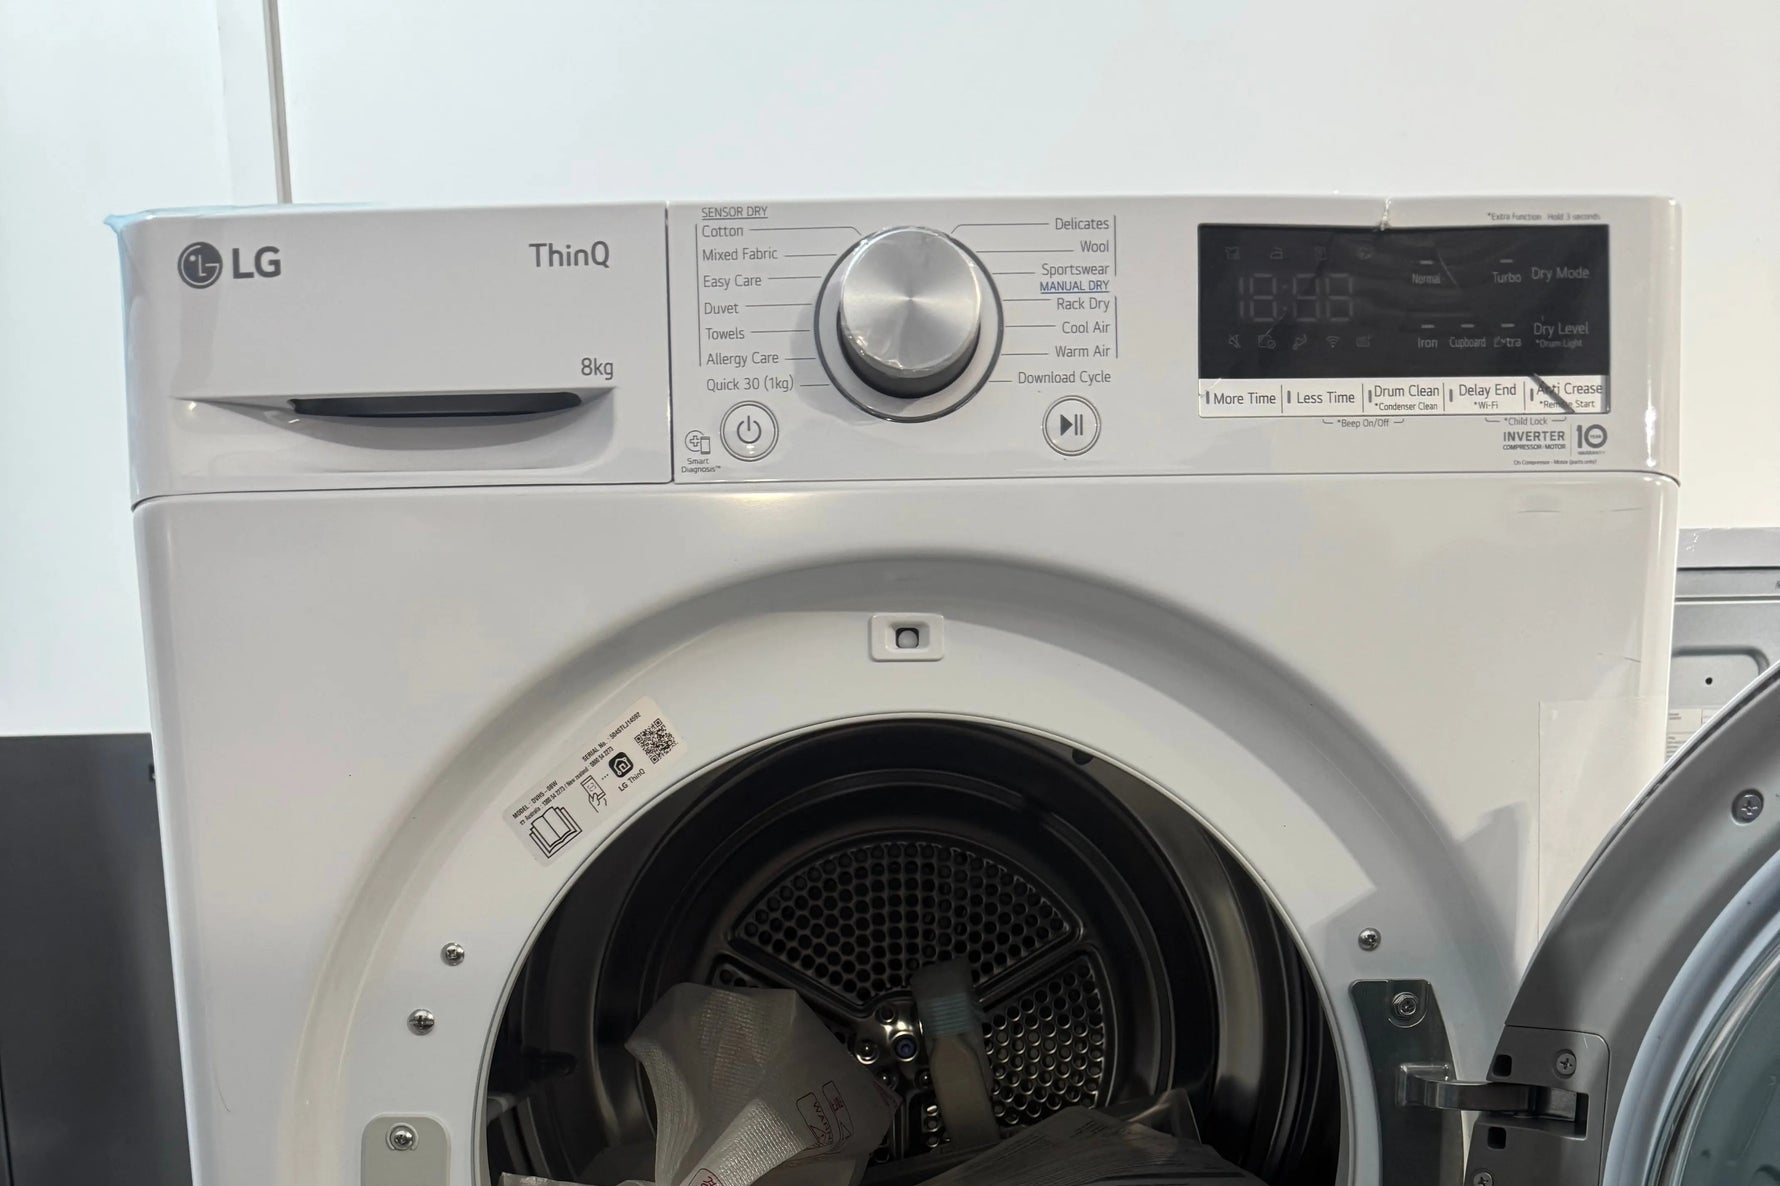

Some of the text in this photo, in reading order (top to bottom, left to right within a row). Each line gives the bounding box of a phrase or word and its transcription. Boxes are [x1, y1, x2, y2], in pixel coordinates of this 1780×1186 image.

[702, 206, 767, 218] SENSOR DRY
[1055, 218, 1109, 229] Delicates
[702, 225, 743, 237] Cotton
[1080, 241, 1109, 252] Wool
[529, 240, 609, 270] ThinQ
[702, 248, 777, 261] Mixed Fabric
[232, 245, 281, 279] LG
[1042, 263, 1109, 278] Sportswear
[1531, 267, 1589, 281] Dry Mode
[704, 274, 762, 289] Easy Care
[1412, 274, 1440, 284] Normal
[1493, 272, 1521, 283] Turbo
[1040, 280, 1109, 291] MANUAL DRY
[704, 302, 738, 314] Duvet
[1057, 298, 1109, 312] Rack Dry
[705, 327, 744, 339] Towels
[1062, 321, 1110, 333] Cool Air
[1534, 322, 1589, 337] Dry Level
[1418, 338, 1438, 348] Iron
[1450, 337, 1486, 348] Cupboard
[1055, 345, 1110, 357] Warm Air
[707, 352, 779, 367] Allergy Care
[580, 357, 614, 380] 8kg
[706, 375, 794, 392] Quick 30 (1kg)
[1018, 370, 1111, 385] Download Cycle
[1374, 385, 1439, 398] Drum Clean
[1459, 384, 1516, 398] Delay End
[1564, 383, 1603, 394] Crease
[1214, 392, 1276, 405] More Time
[1297, 391, 1354, 403] Less Time
[1417, 402, 1437, 410] Clean
[1576, 400, 1595, 408] Start
[1362, 419, 1389, 427] On/Off
[1530, 417, 1547, 425] Lock
[1503, 431, 1565, 441] INVERTER
[617, 768, 645, 792] LG ThinQ
[512, 804, 529, 819] MODEL
